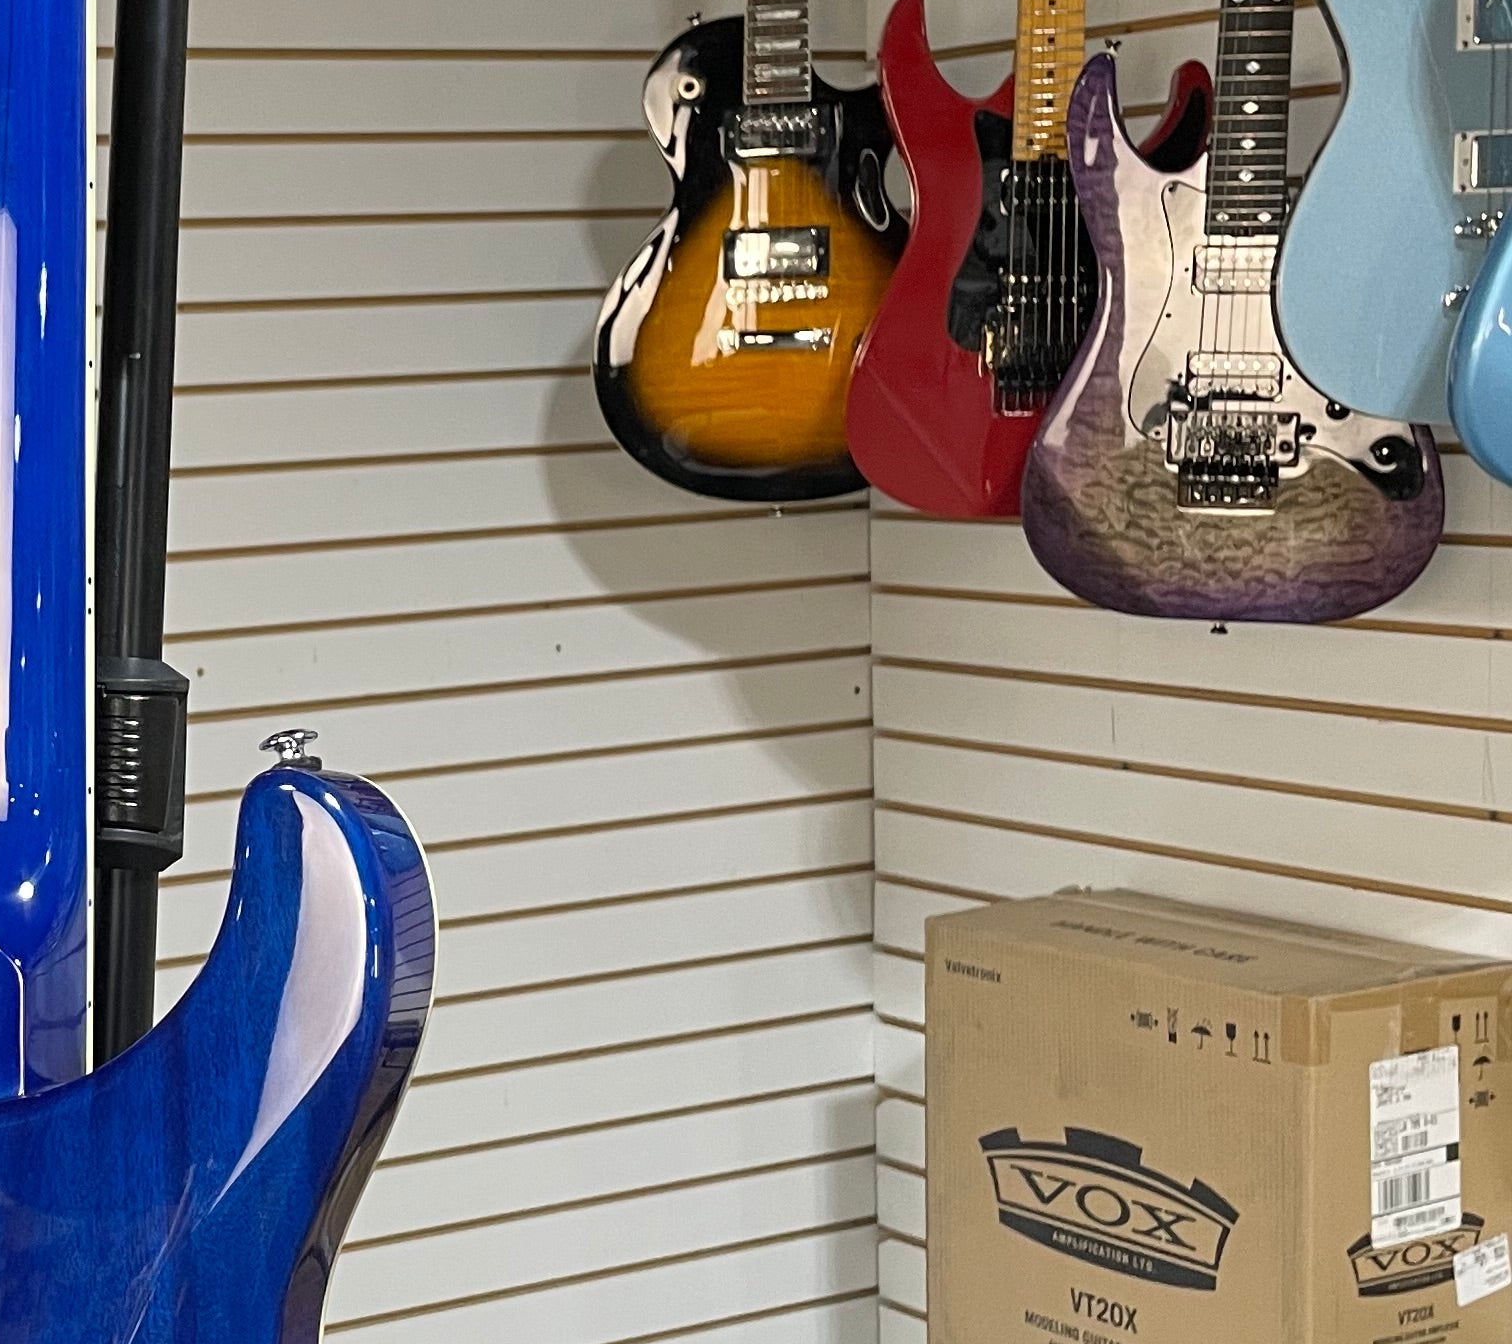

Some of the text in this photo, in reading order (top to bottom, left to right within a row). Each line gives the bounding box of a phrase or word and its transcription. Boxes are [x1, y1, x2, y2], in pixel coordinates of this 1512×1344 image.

[1010, 1163, 1197, 1252] VOX
[1369, 1235, 1465, 1271] VOX
[1025, 1309, 1079, 1342] MODELING
[1070, 1287, 1138, 1334] VT20X
